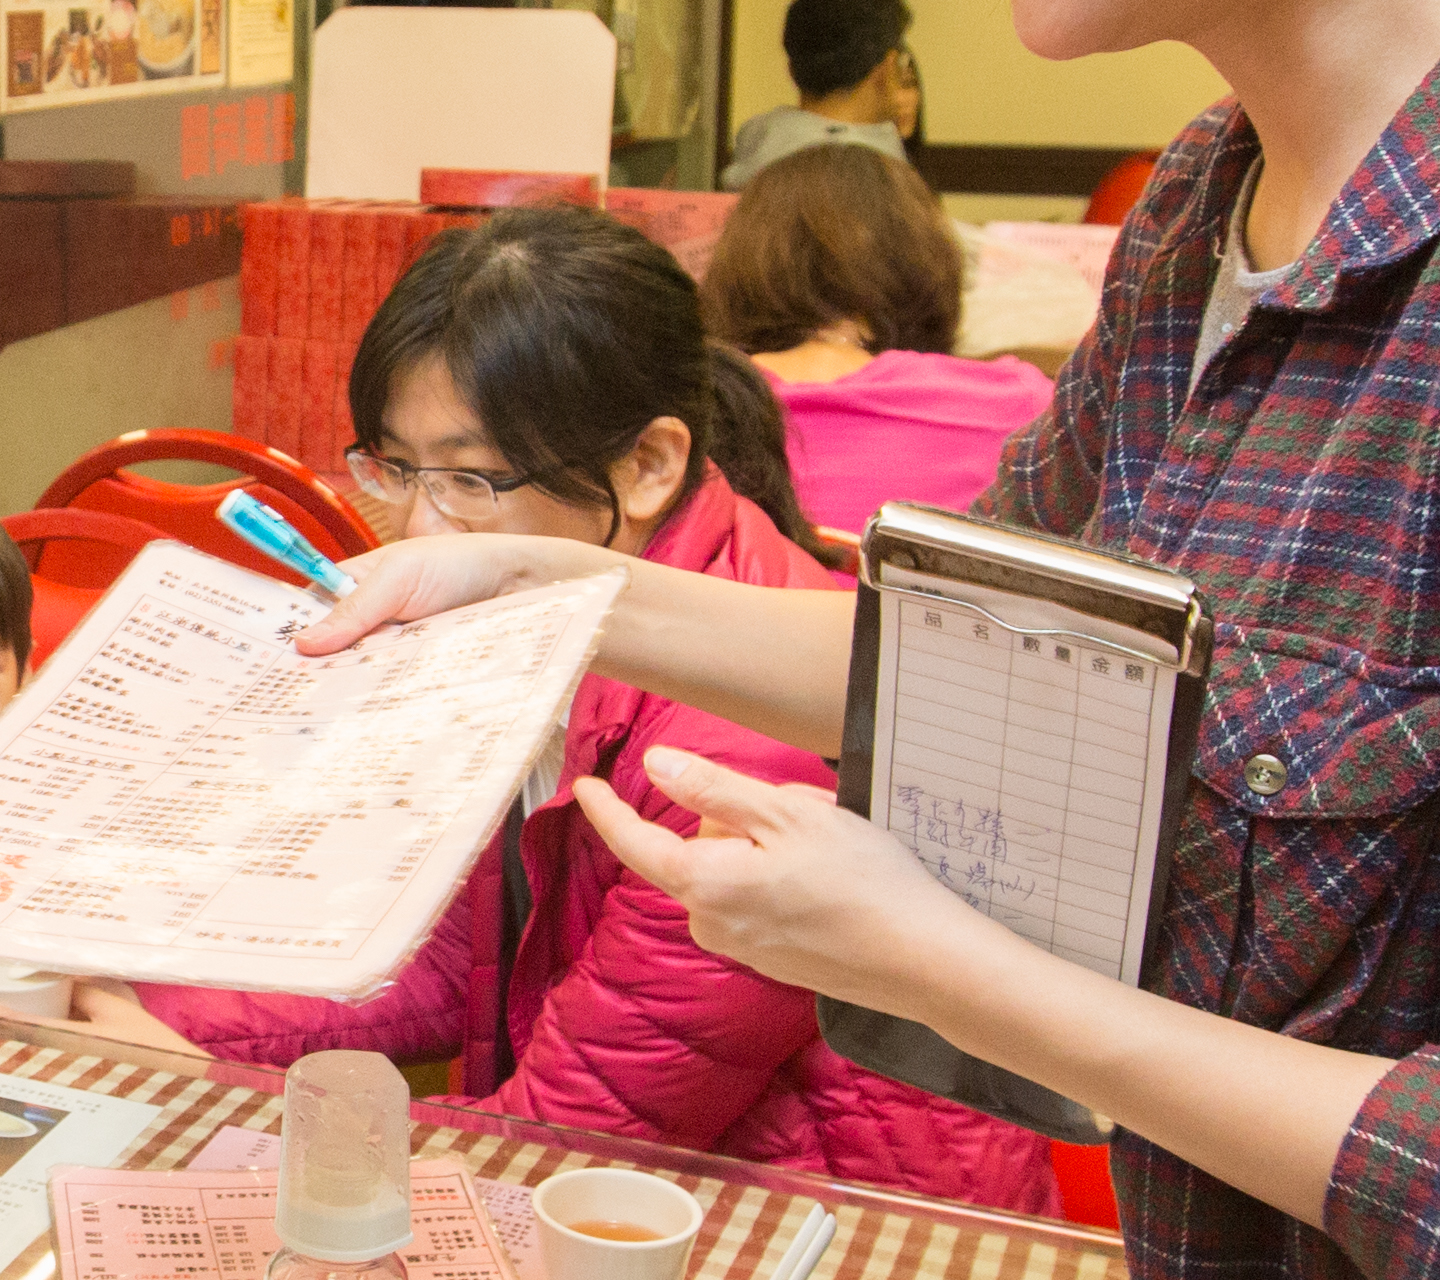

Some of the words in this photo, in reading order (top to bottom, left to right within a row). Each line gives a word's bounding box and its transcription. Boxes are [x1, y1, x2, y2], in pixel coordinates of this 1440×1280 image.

[153, 609, 257, 653] 江浙傳統小點
[924, 610, 990, 640] 品名
[1023, 635, 1072, 663] 數量
[1091, 656, 1145, 683] 金額
